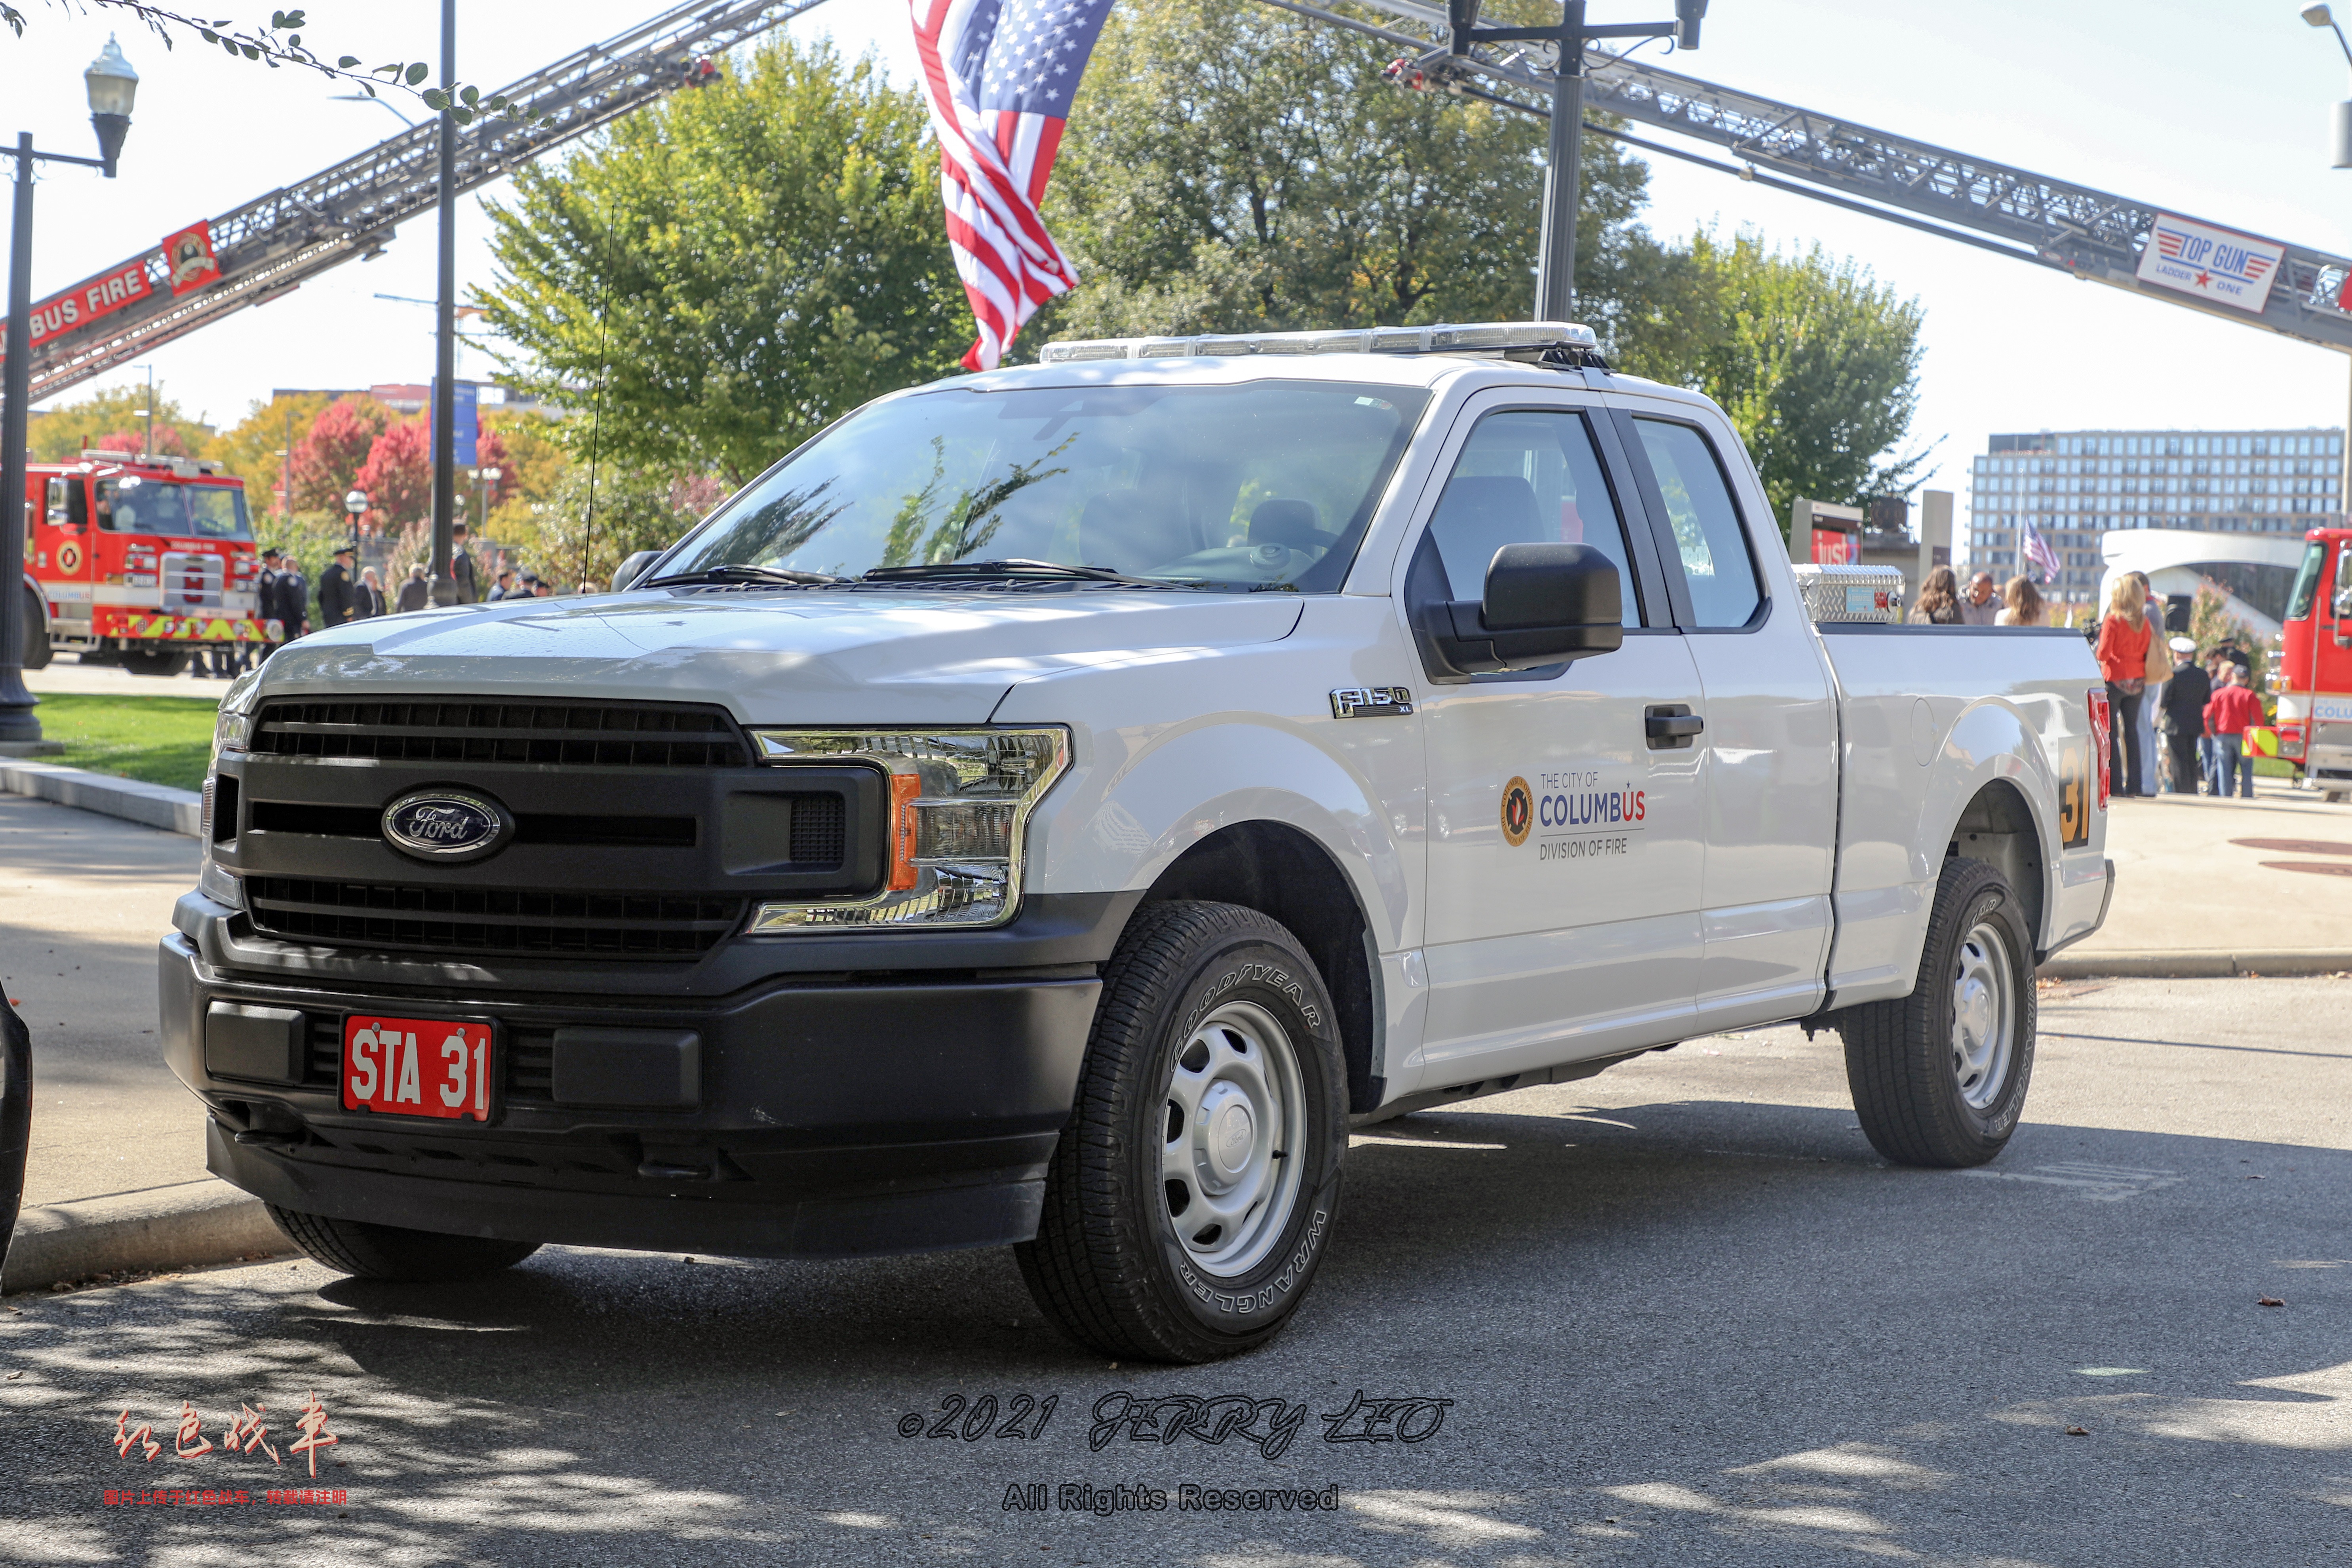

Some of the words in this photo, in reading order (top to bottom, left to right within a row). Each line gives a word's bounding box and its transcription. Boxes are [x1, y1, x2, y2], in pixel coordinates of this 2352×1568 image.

[2179, 235, 2213, 262] TOP
[2213, 243, 2250, 274] GUN
[2156, 264, 2192, 281] LADDER
[2217, 280, 2243, 296] ONE
[29, 299, 80, 340] BUS
[86, 268, 143, 313] FIRE
[1502, 778, 1523, 807] COLUMBUS
[1524, 784, 1532, 805] OHIO
[1541, 773, 1559, 789] THE
[1562, 772, 1583, 788] CITY
[1585, 771, 1598, 787] OF
[2060, 745, 2089, 843] 31
[409, 806, 470, 839] Ford
[1540, 790, 1645, 827] COLUMBUS
[1501, 816, 1517, 844] DIVISION
[1540, 841, 1585, 861] DIVISION
[1589, 840, 1603, 856] OF
[1606, 838, 1627, 855] FIRE
[1171, 964, 1321, 1072] GOODYEAR
[351, 1029, 421, 1104] STA
[440, 1035, 486, 1109] 31
[1994, 974, 2035, 1132] WRANGLER
[1180, 1210, 1326, 1313] WRANGLER
